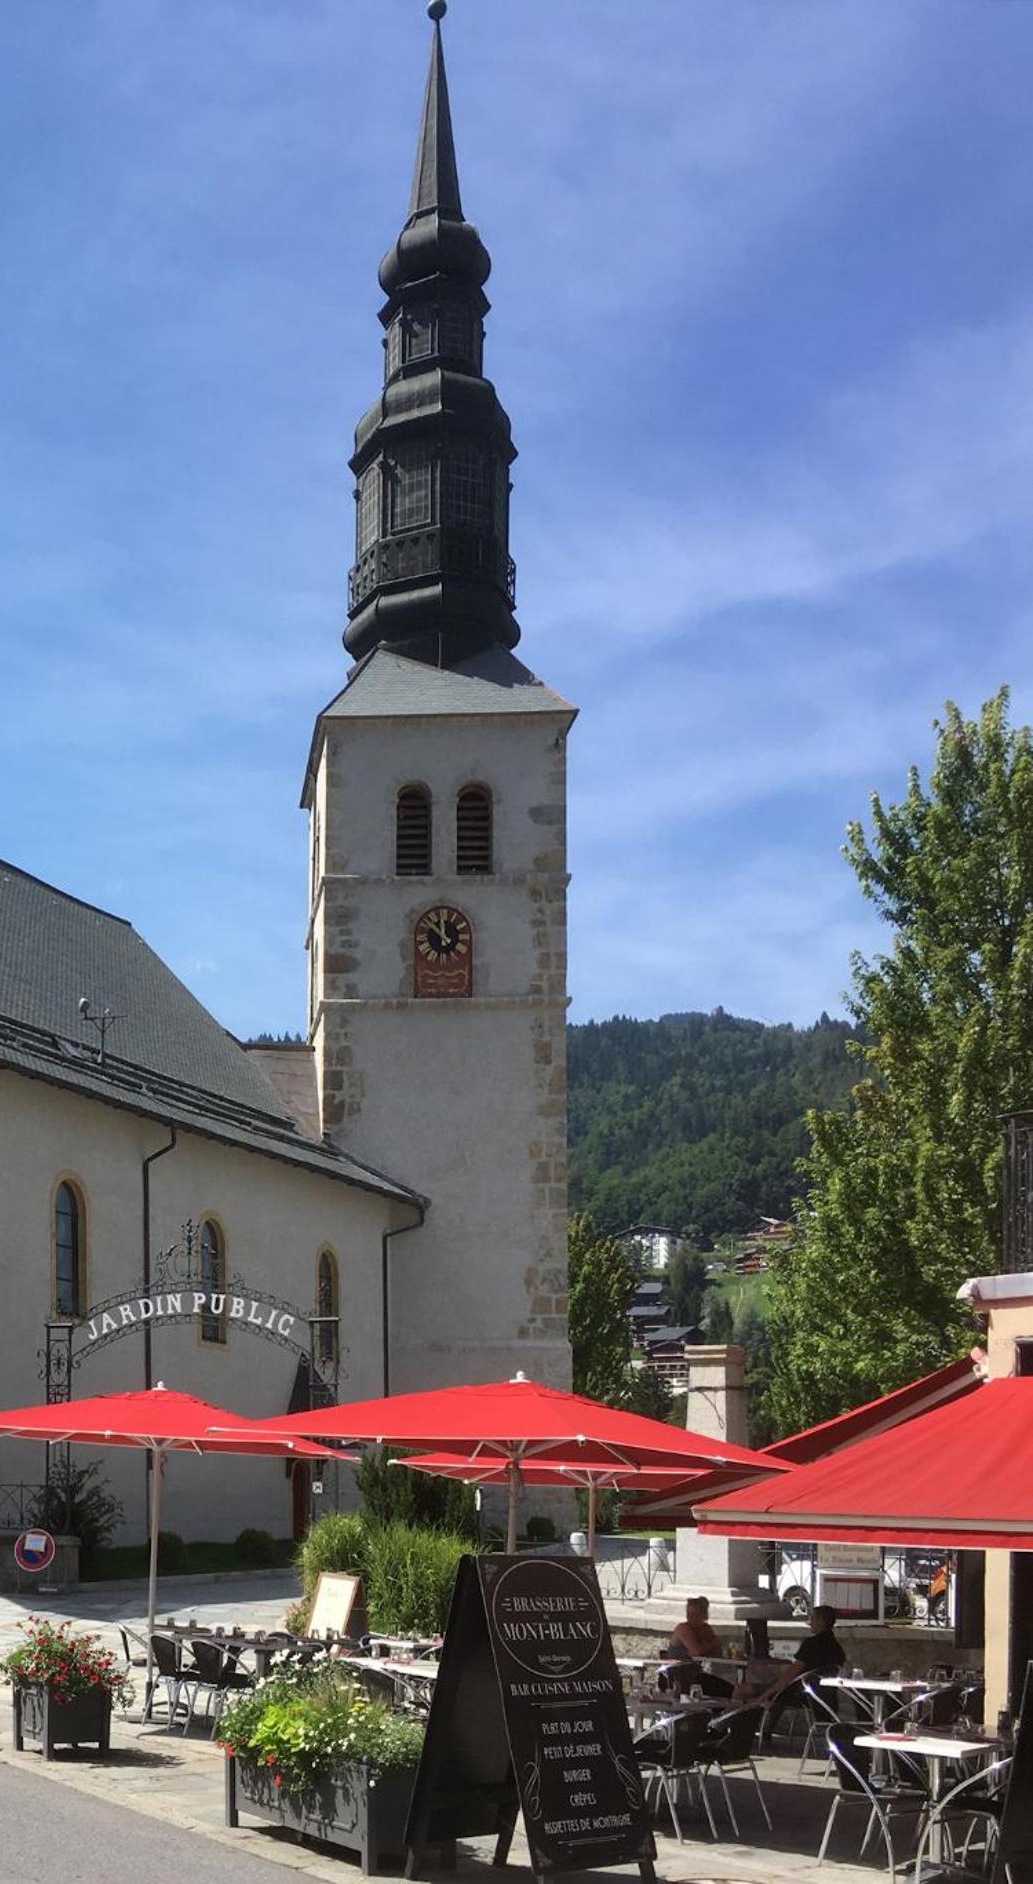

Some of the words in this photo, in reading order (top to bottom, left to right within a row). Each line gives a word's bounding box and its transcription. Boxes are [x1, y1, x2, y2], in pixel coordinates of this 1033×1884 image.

[87, 1293, 182, 1340] JARDIN
[192, 1292, 295, 1337] PUBLIC
[513, 1597, 578, 1612] BRASSERIE
[503, 1622, 599, 1641] MONT-BLANC
[510, 1683, 530, 1696] BAR
[531, 1681, 571, 1695] CUISINE
[573, 1679, 614, 1693] MAISON
[542, 1722, 559, 1735] PLAT
[560, 1721, 572, 1734] DU
[573, 1720, 594, 1733] JOUR
[544, 1746, 563, 1759] PETIT
[564, 1743, 602, 1758] DÉJEUNER
[563, 1769, 591, 1782] BURGER
[569, 1791, 597, 1807] CRÊPES
[544, 1819, 580, 1834] ASSIETTES
[580, 1818, 591, 1831] DE
[593, 1813, 632, 1829] MONTAGNE
